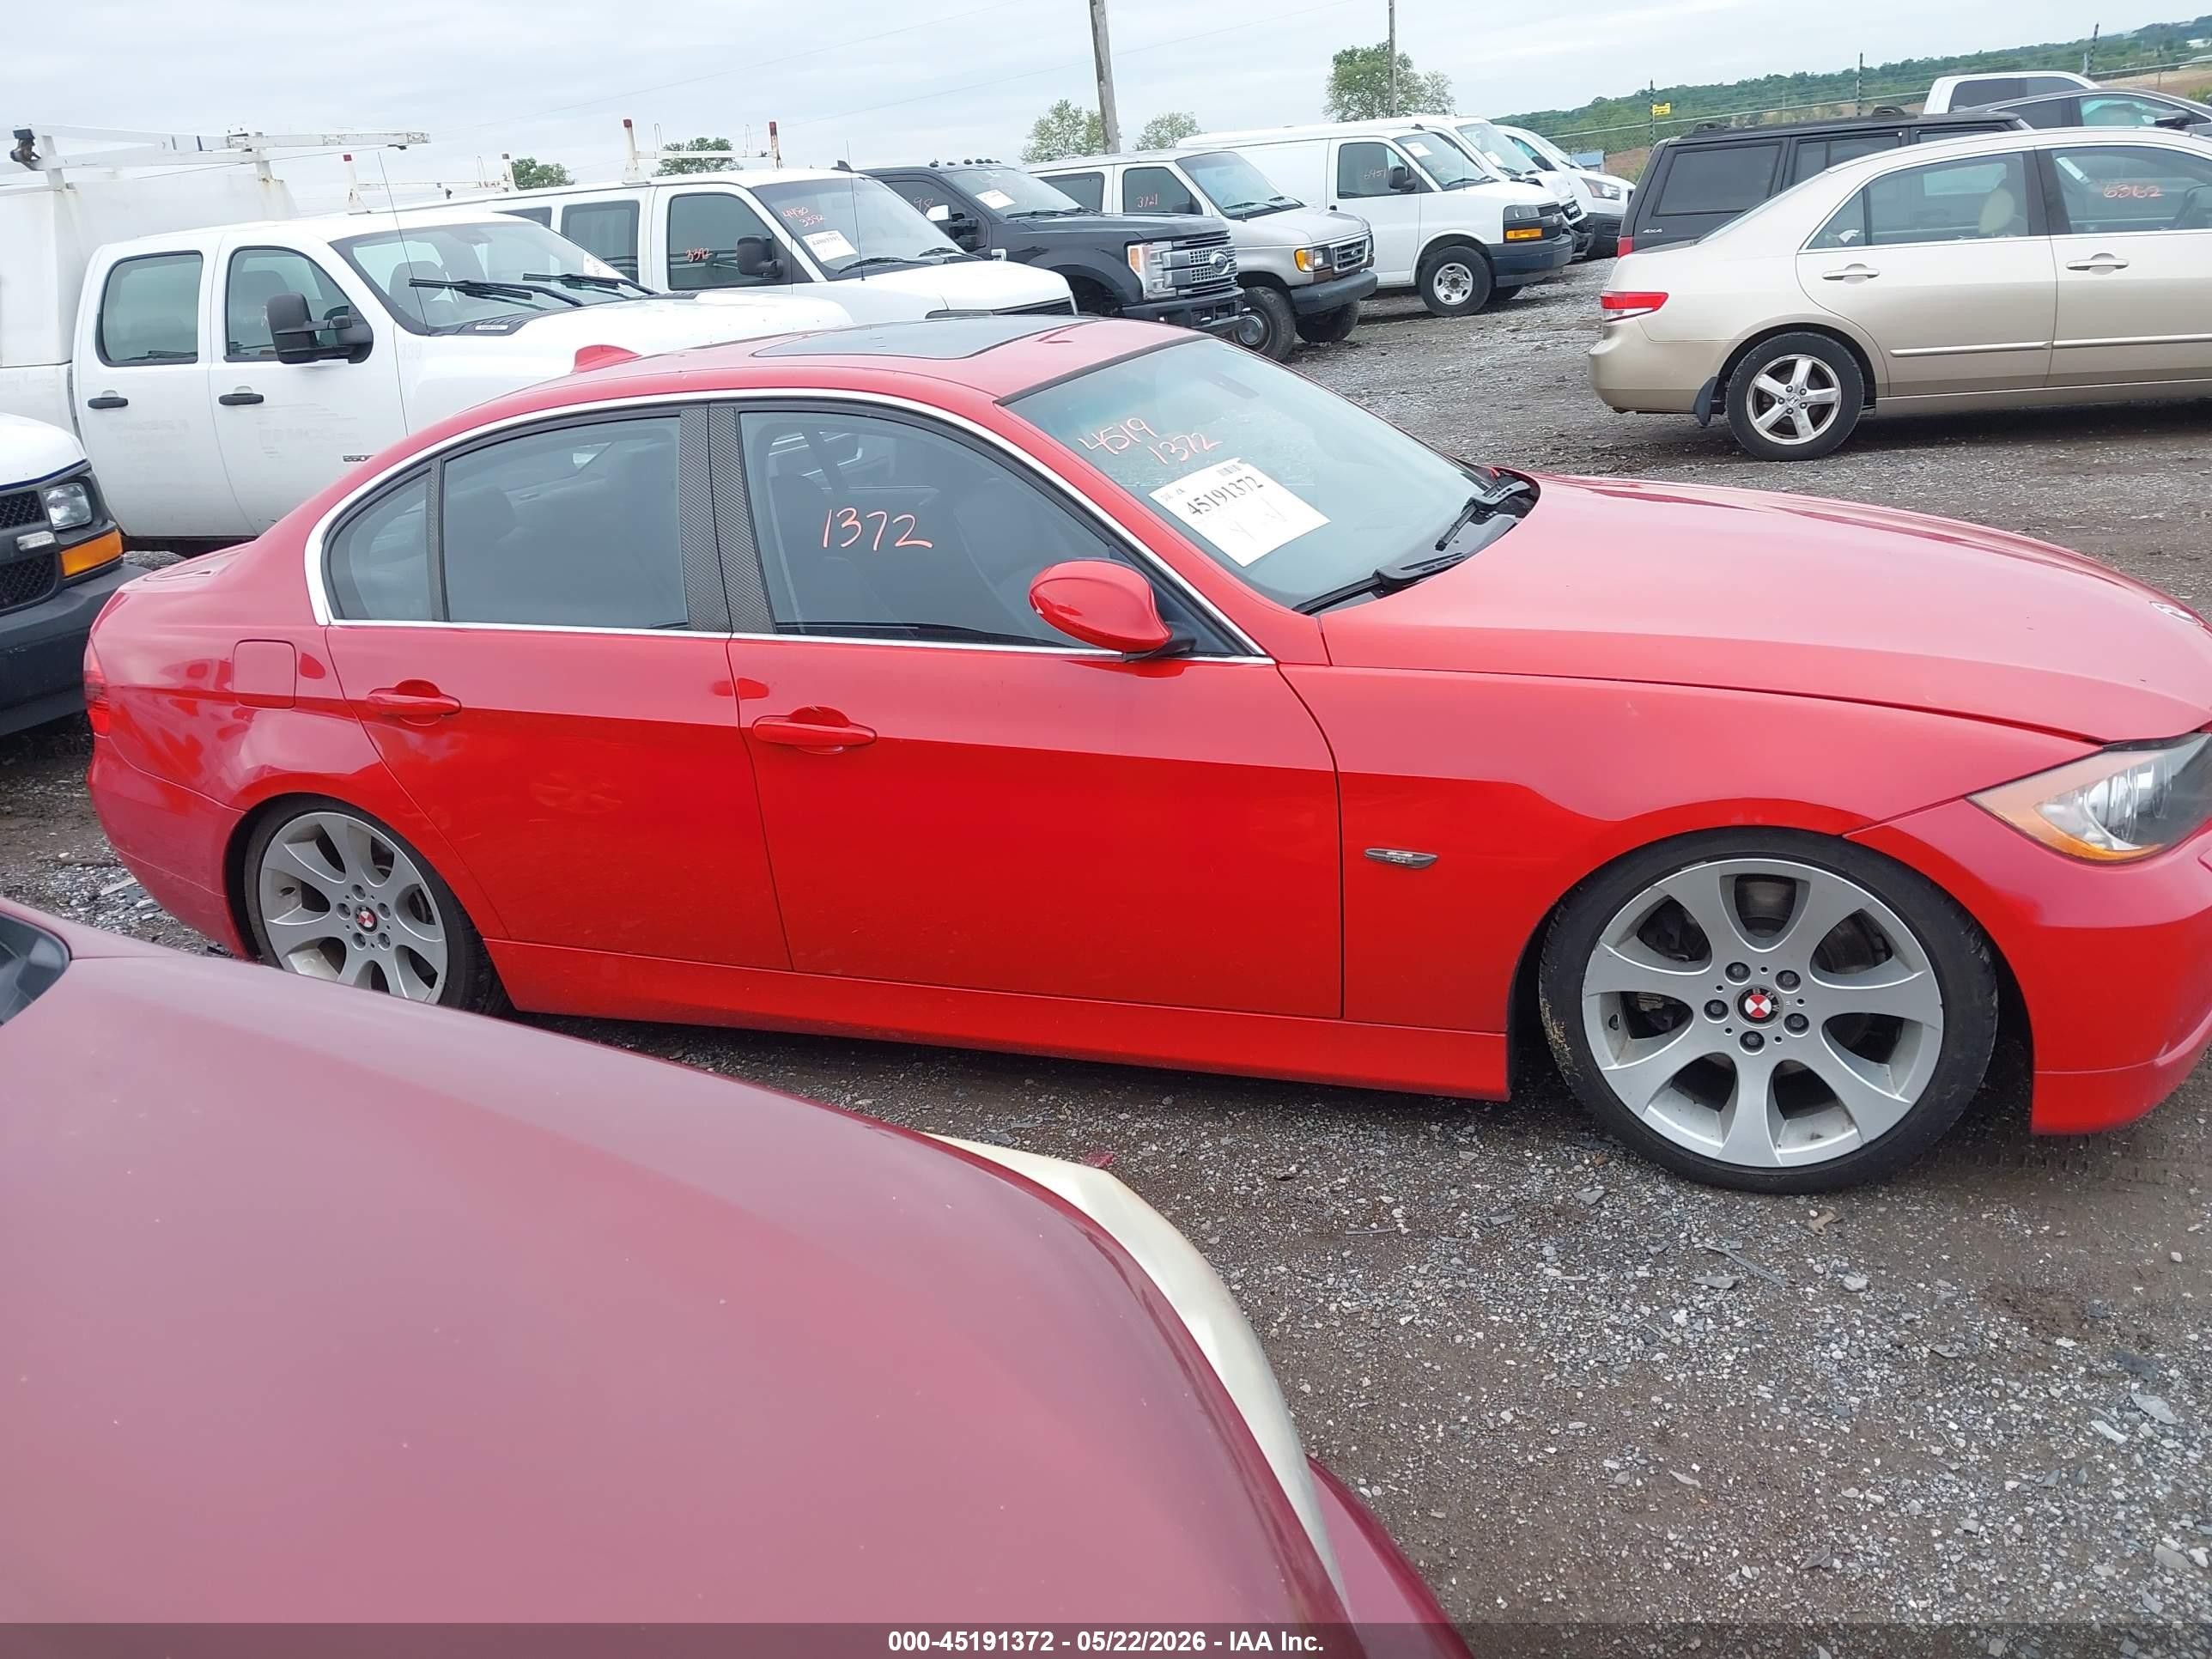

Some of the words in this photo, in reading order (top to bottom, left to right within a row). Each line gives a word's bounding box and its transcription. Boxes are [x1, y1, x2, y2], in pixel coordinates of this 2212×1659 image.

[1078, 417, 1158, 455] 4519
[1147, 432, 1224, 465] 1372
[343, 454, 374, 463] 250
[1187, 476, 1264, 515] 45191372
[823, 507, 934, 551] 1372
[1752, 988, 1781, 1012] BMW
